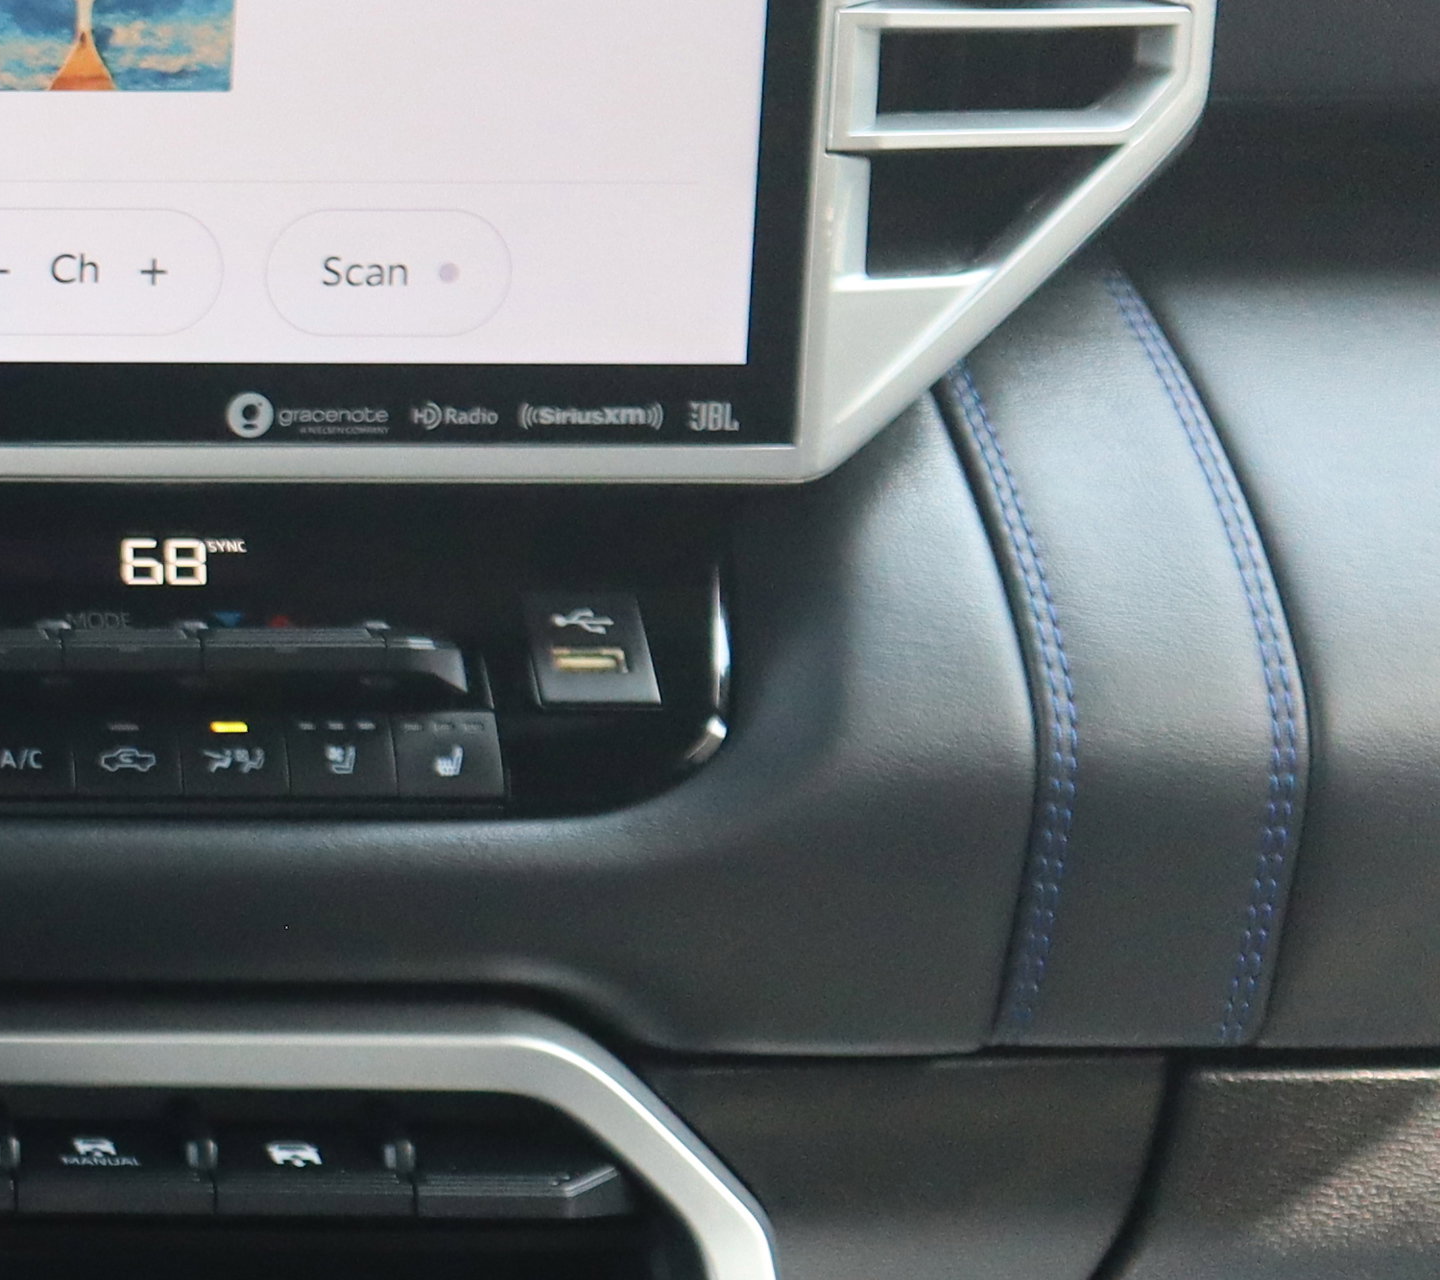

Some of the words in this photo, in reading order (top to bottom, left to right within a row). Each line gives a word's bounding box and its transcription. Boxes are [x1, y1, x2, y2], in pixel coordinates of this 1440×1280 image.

[49, 254, 100, 287] Ch
[321, 255, 410, 288] Scan
[279, 406, 390, 427] gracenote
[444, 406, 499, 425] Radio
[206, 540, 248, 554] SYNC
[120, 537, 208, 586] 68
